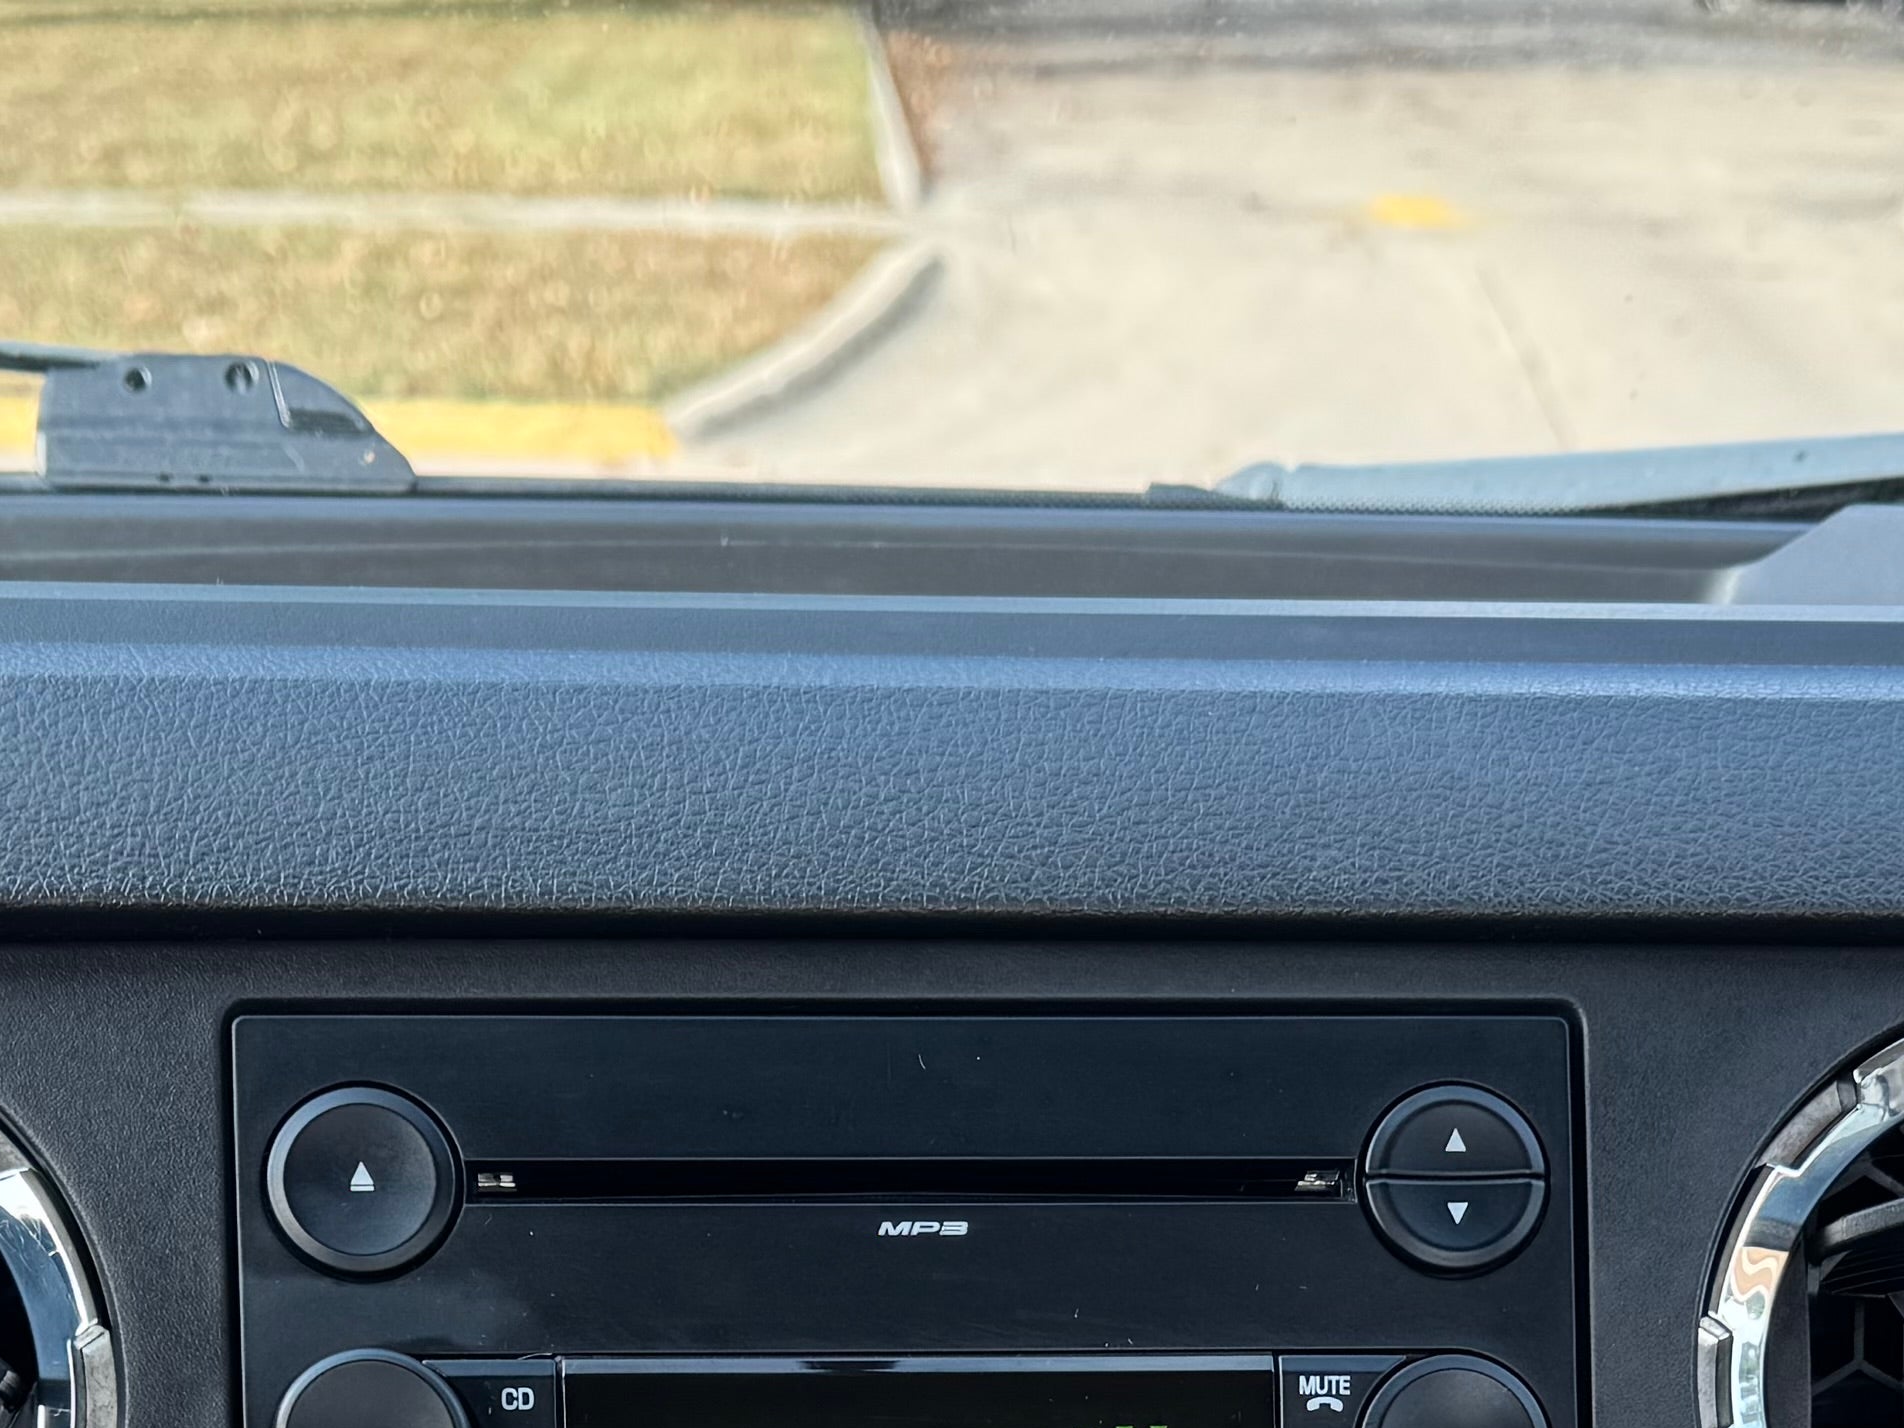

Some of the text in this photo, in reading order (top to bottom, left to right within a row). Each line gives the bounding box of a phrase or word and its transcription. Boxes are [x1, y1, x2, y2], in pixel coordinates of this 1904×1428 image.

[878, 1221, 969, 1236] MP3
[1299, 1375, 1351, 1396] MUTE
[501, 1387, 535, 1411] CD
